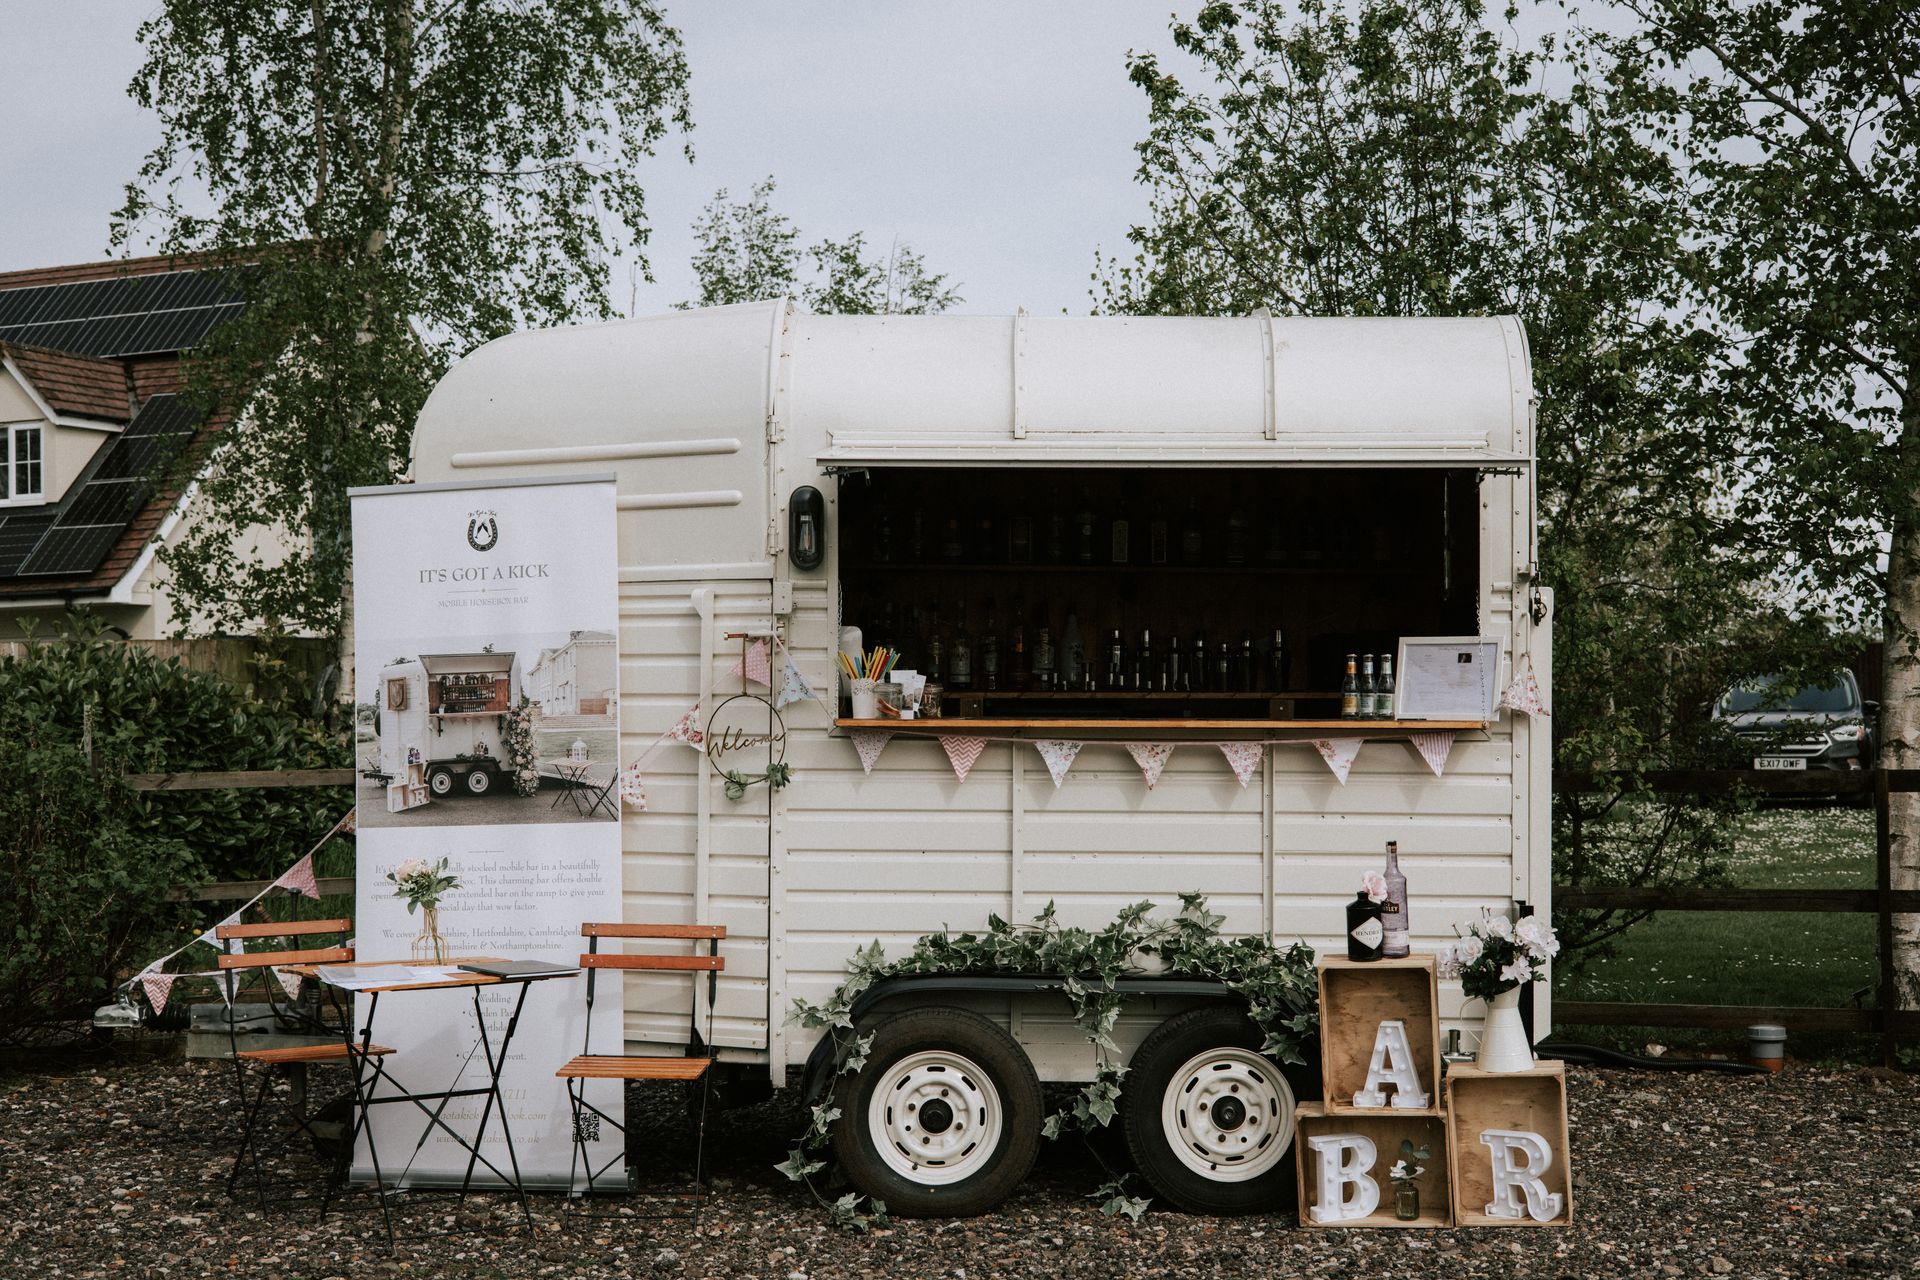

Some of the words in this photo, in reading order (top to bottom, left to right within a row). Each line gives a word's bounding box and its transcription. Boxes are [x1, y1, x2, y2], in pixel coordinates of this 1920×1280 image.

[419, 568, 447, 583] IT'S
[452, 567, 489, 582] GOT
[492, 566, 504, 580] A
[508, 564, 550, 579] KICK
[438, 599, 468, 608] MOBILE
[470, 597, 511, 607] HORSEBOX
[514, 596, 529, 605] BAR
[707, 726, 787, 758] Welcome
[375, 864, 387, 875] It's
[448, 862, 465, 875] fully
[468, 861, 497, 872] stocked
[500, 860, 525, 872] mobile
[526, 859, 539, 871] bar
[541, 862, 550, 871] in
[559, 858, 601, 872] beautifully
[478, 874, 497, 885] This
[498, 873, 534, 885] charming
[536, 873, 549, 884] bar
[551, 873, 574, 884] offers
[576, 872, 603, 883] double
[458, 888, 492, 899] extended
[494, 887, 508, 898] bar
[521, 887, 533, 897] the
[536, 890, 557, 899] ramp
[570, 888, 586, 898] give
[587, 890, 606, 898] your
[461, 901, 475, 913] day
[477, 901, 493, 911] that
[382, 929, 395, 938] We
[396, 931, 416, 939] cover
[472, 925, 526, 938] Hertfordshire,
[480, 941, 488, 950] &
[489, 939, 564, 951] Northamptonshire.
[479, 993, 512, 1004] Wedding
[1353, 1020, 1431, 1109] A
[1308, 1132, 1381, 1224] B
[1479, 1128, 1564, 1223] R
